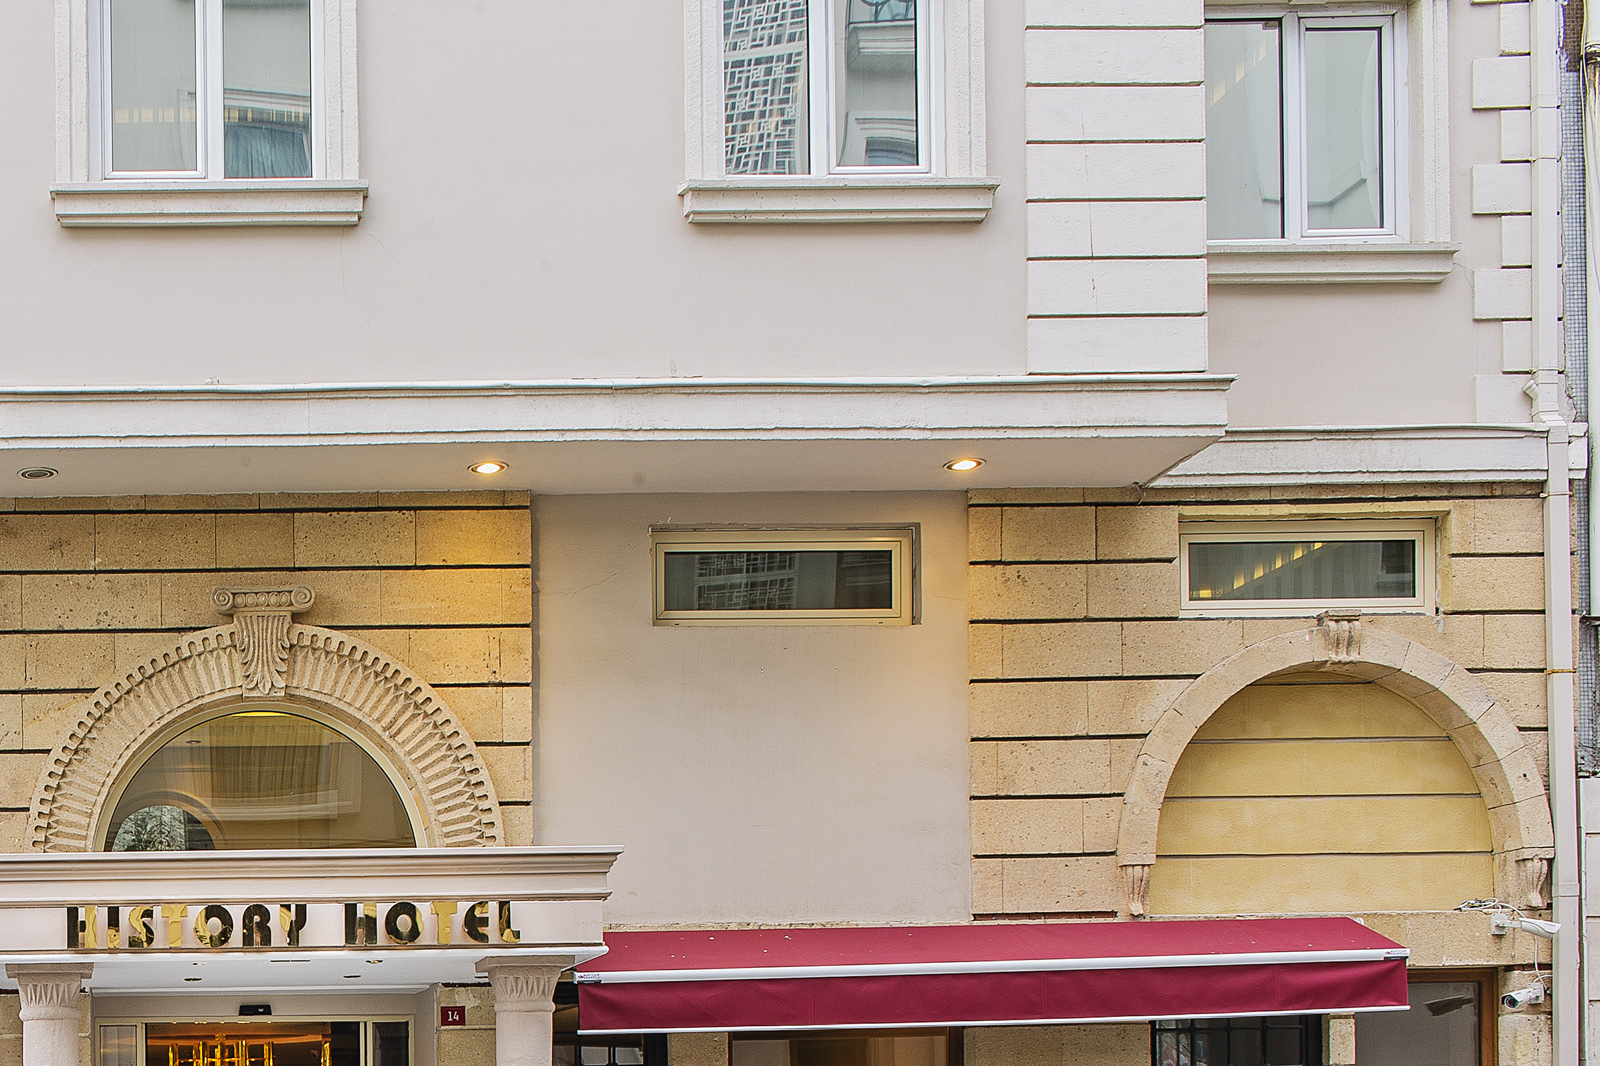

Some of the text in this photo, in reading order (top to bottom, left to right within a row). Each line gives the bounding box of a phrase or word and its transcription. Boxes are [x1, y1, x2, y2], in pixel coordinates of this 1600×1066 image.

[67, 901, 520, 949] HISTORY HOTEL
[447, 1010, 459, 1021] 14
